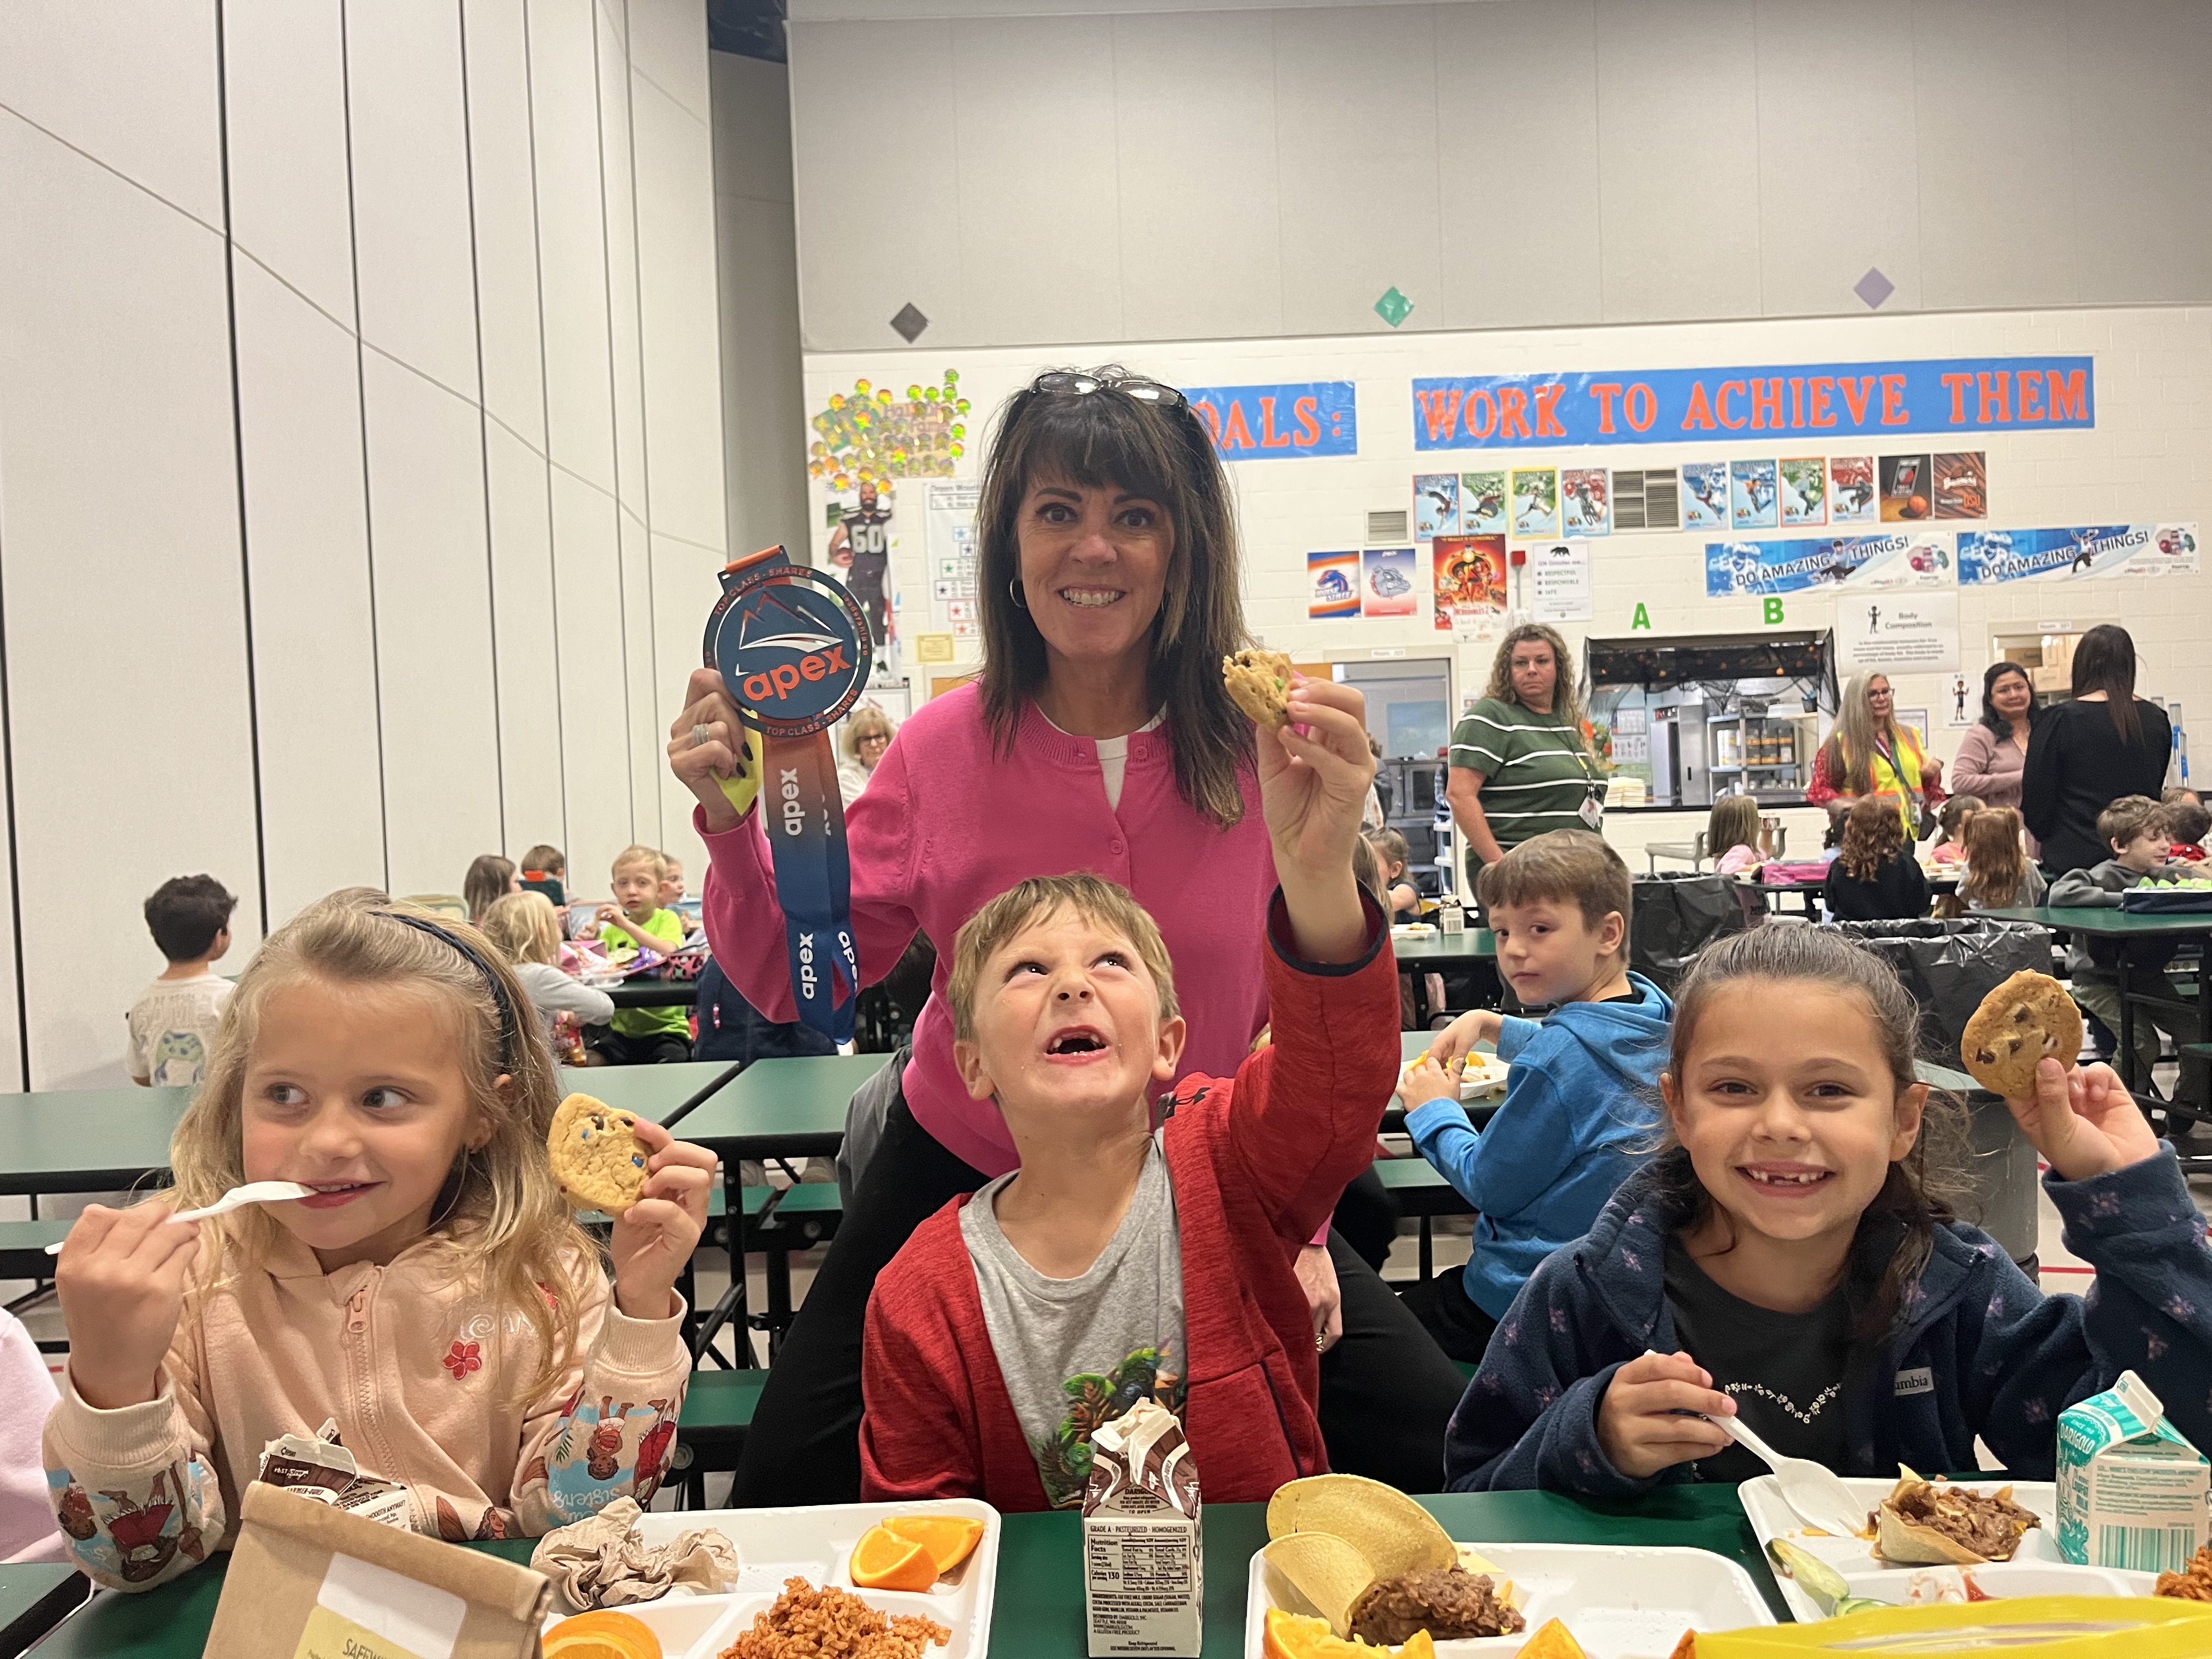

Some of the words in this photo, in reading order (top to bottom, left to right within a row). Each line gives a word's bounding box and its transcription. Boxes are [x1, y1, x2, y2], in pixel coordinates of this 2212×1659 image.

[1417, 384, 1567, 441] WORK
[1590, 383, 1657, 433] TO
[1681, 374, 1909, 430] ACHIEVE
[1942, 370, 2089, 424] THEM
[851, 524, 884, 554] 60
[1735, 572, 1759, 586] DO
[1761, 554, 1831, 581] AMAZING
[1850, 535, 1910, 561] THINGS!
[1982, 563, 2003, 579] DO
[2007, 546, 2077, 574] AMAZING
[2092, 531, 2149, 555] THINGS!
[729, 572, 760, 596] CLASS
[769, 567, 812, 578] SHARES
[1632, 602, 1651, 630] A
[1764, 597, 1784, 624] B
[1885, 621, 1933, 630] Composition
[1898, 612, 1918, 620] Body
[743, 646, 851, 701] apex
[766, 726, 786, 736] TOP
[788, 721, 821, 736] CLASS
[826, 689, 858, 723] SHARES
[781, 768, 805, 836] apex
[800, 933, 819, 1000] apex
[2060, 1423, 2096, 1454] DARIGOLD
[1108, 1571, 1120, 1579] 130
